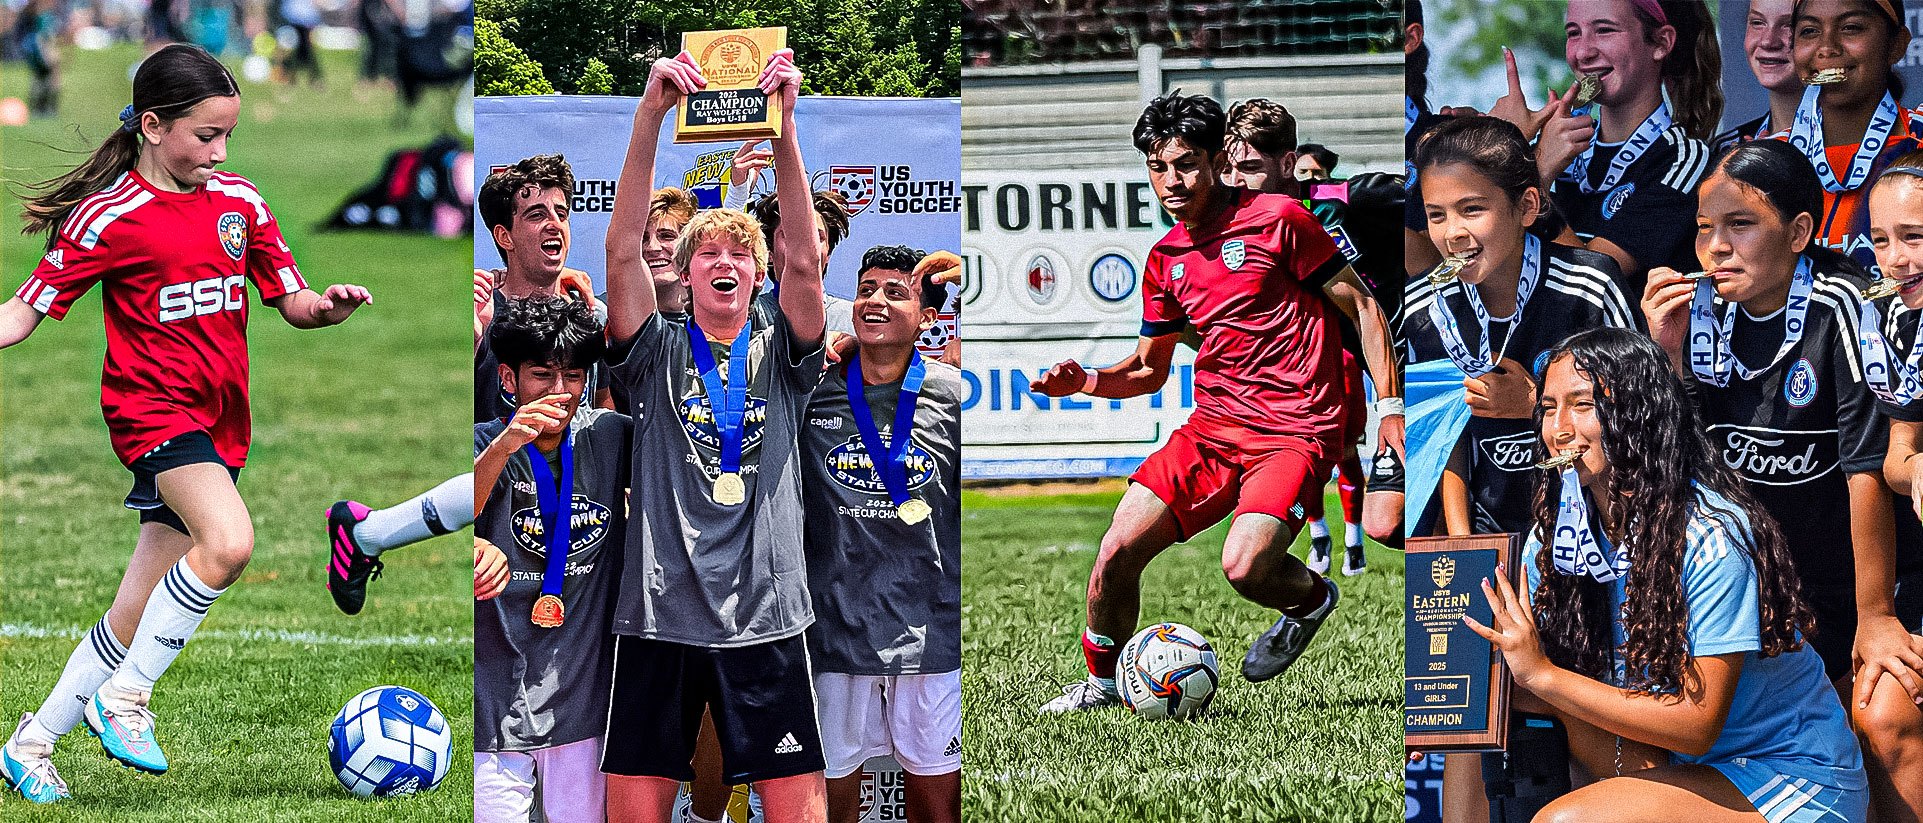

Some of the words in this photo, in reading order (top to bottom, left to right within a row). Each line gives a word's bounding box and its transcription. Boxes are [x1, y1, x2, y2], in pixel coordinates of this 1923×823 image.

[702, 66, 757, 77] NATIONAL
[718, 91, 738, 99] 2022
[691, 97, 764, 111] CHAMPION
[697, 150, 736, 167] EASTE
[683, 162, 725, 191] NEW
[880, 166, 910, 182] US
[573, 181, 616, 196] UTH
[879, 181, 954, 197] YOUTH
[572, 197, 615, 212] CCE
[159, 274, 245, 322] SSC
[810, 416, 843, 429] capelli
[1494, 437, 1536, 465] For
[1723, 431, 1819, 475] Ford
[836, 470, 886, 490] STATE
[865, 499, 895, 508] 2022
[838, 506, 860, 518] STATE
[860, 509, 877, 518] CUP
[572, 527, 603, 550] CUP
[512, 571, 541, 581] STATE
[1413, 593, 1470, 609] EASTERN
[1126, 643, 1142, 695] molten
[1428, 661, 1446, 671] 2025
[1414, 683, 1421, 691] 13
[1437, 682, 1458, 690] Under
[1424, 694, 1446, 703] GIRLS
[1406, 713, 1463, 726] CHAMPION
[774, 744, 803, 754] adidas
